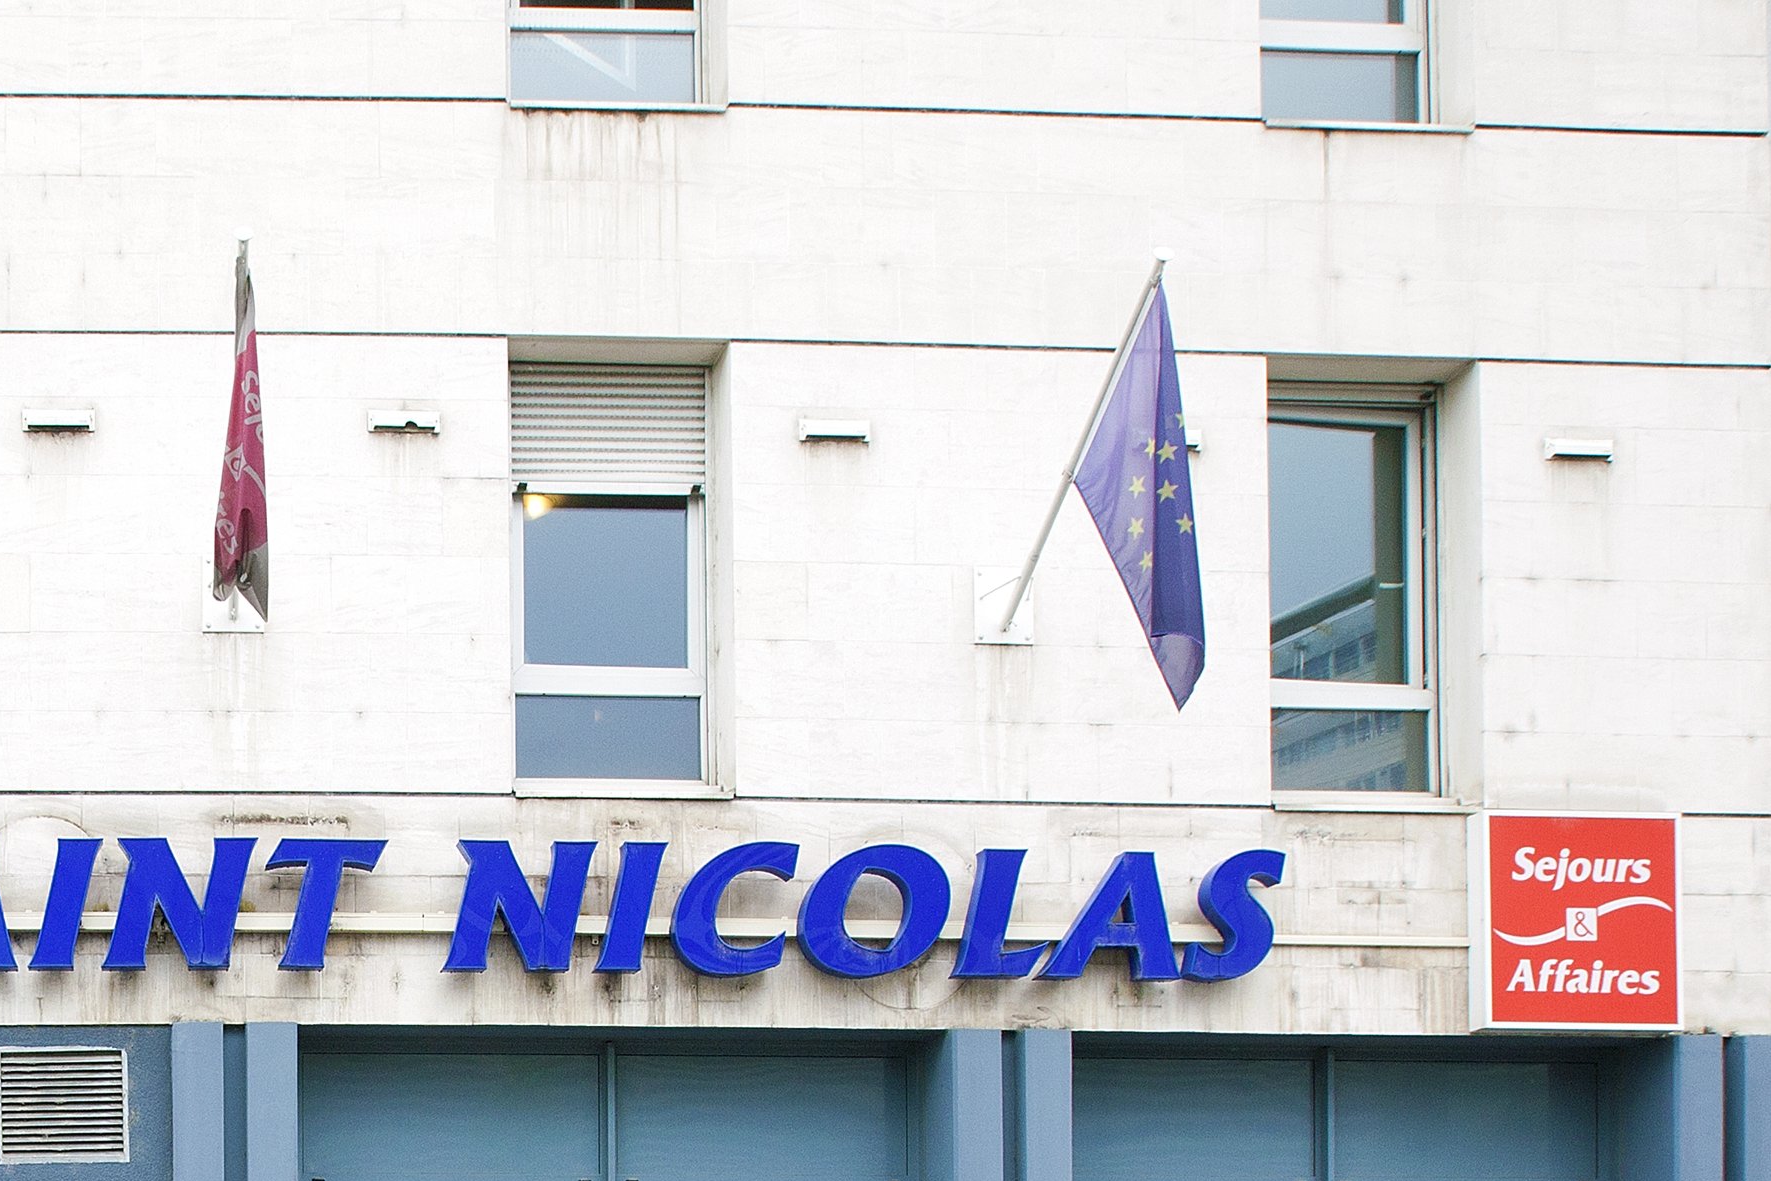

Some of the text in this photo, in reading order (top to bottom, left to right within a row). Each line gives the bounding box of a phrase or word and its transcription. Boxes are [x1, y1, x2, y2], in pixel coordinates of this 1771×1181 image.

[1511, 846, 1652, 891] Sejours
[439, 838, 1288, 983] NICOLAS
[1573, 911, 1594, 937] &
[1505, 958, 1660, 995] Affaires
